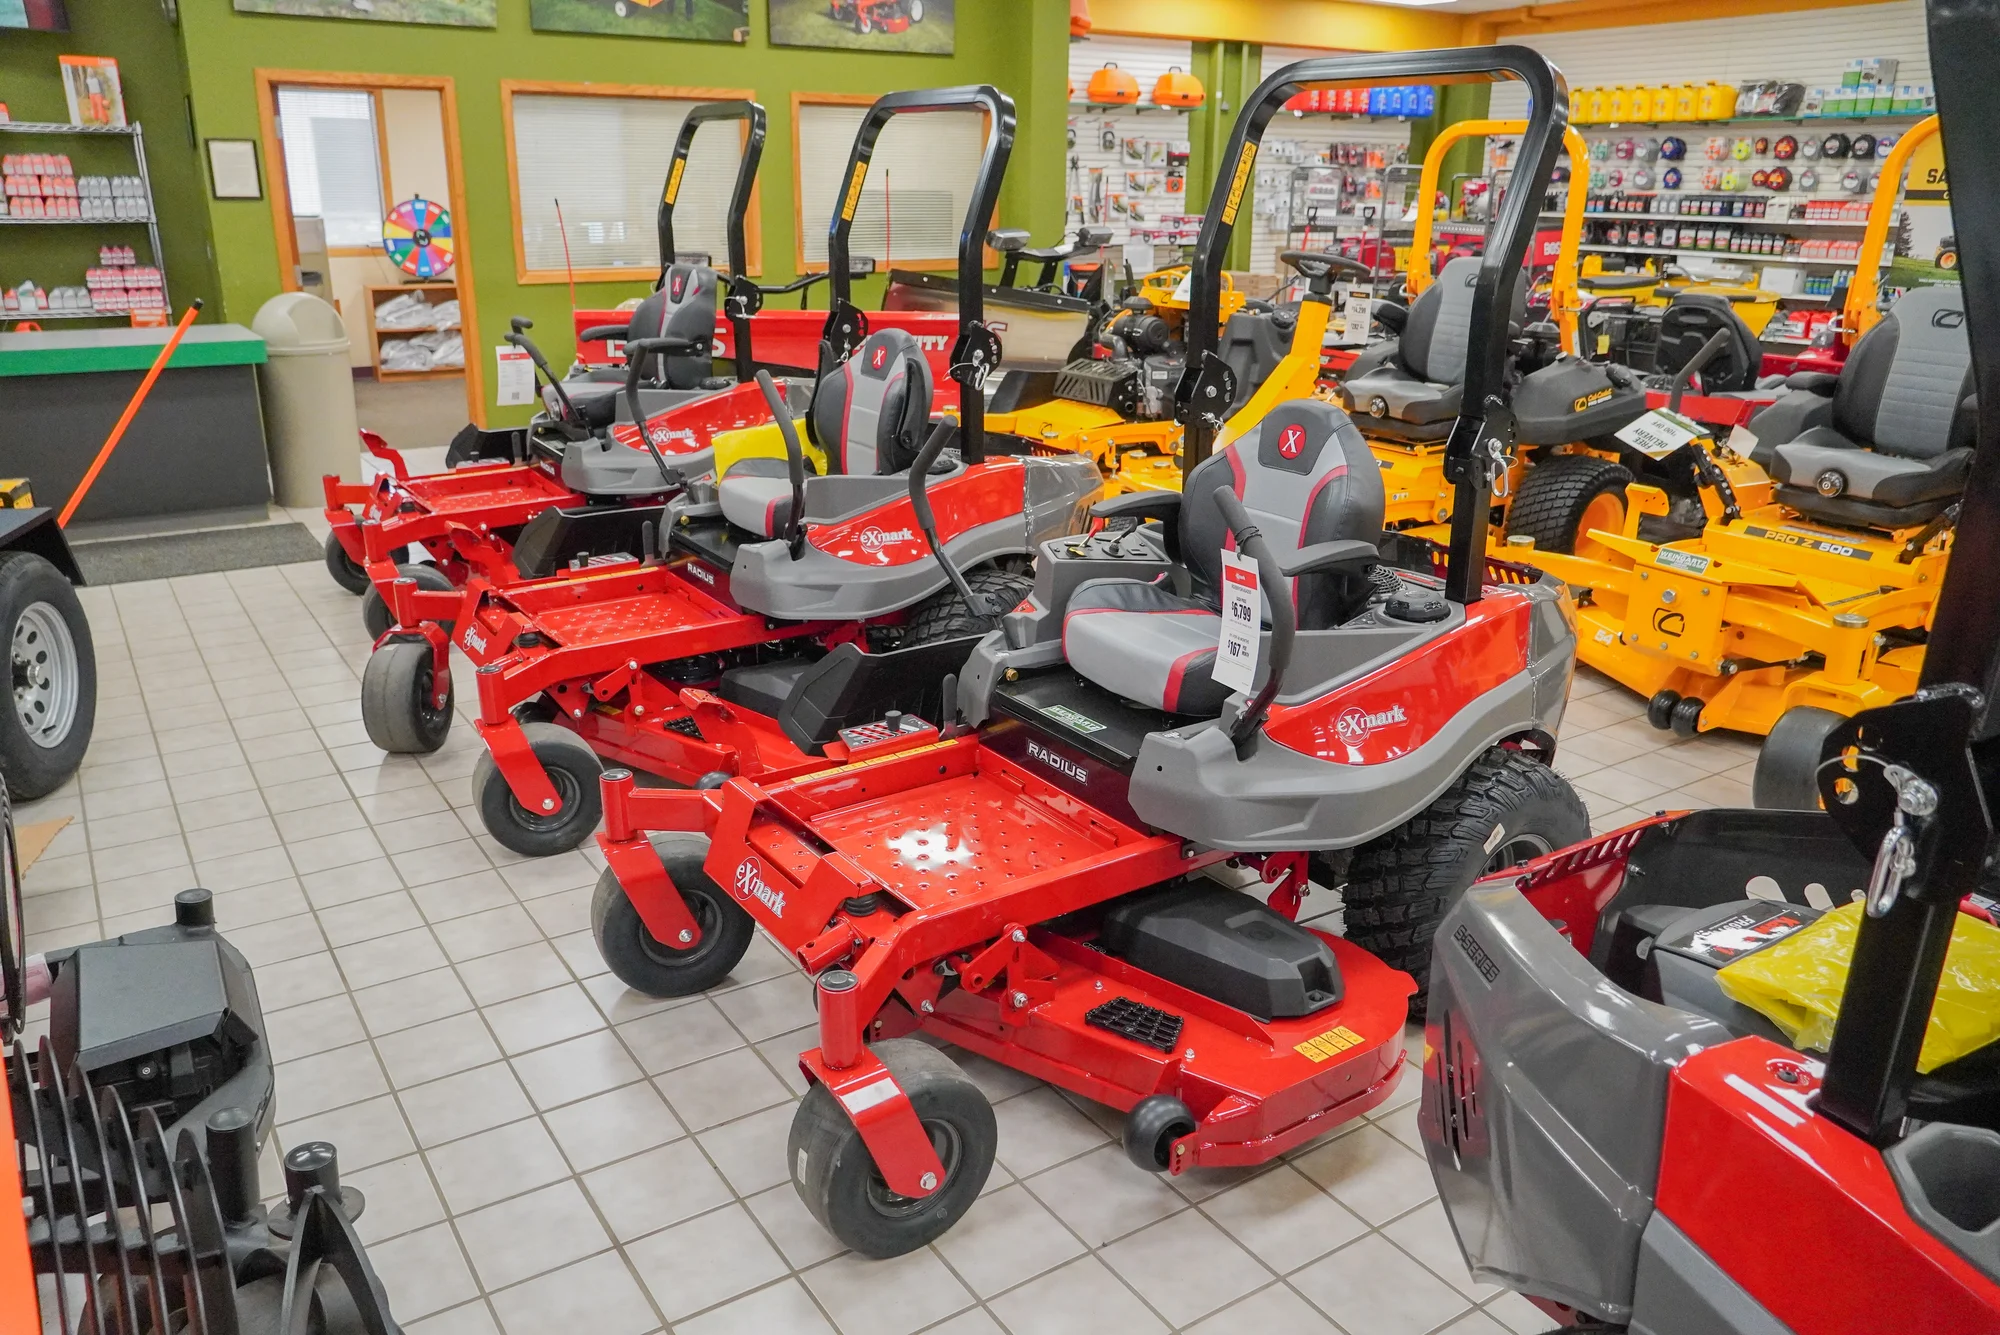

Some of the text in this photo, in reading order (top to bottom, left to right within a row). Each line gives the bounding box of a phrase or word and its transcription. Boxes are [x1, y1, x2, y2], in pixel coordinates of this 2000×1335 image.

[873, 348, 885, 367] X
[1281, 429, 1302, 453] X
[1632, 437, 1652, 450] FREE
[1633, 427, 1669, 449] DELIVERY
[860, 527, 914, 546] eXmark
[1764, 529, 1799, 545] PRO
[1801, 538, 1815, 549] Z
[1818, 542, 1854, 557] 500
[687, 562, 714, 585] RADIUS
[1231, 601, 1252, 623] $6,799
[1227, 639, 1241, 658] $167
[1337, 704, 1407, 738] eXmark
[1028, 741, 1088, 784] RADIUS
[735, 861, 787, 919] eXmark
[1453, 923, 1501, 984] S-SERIES
